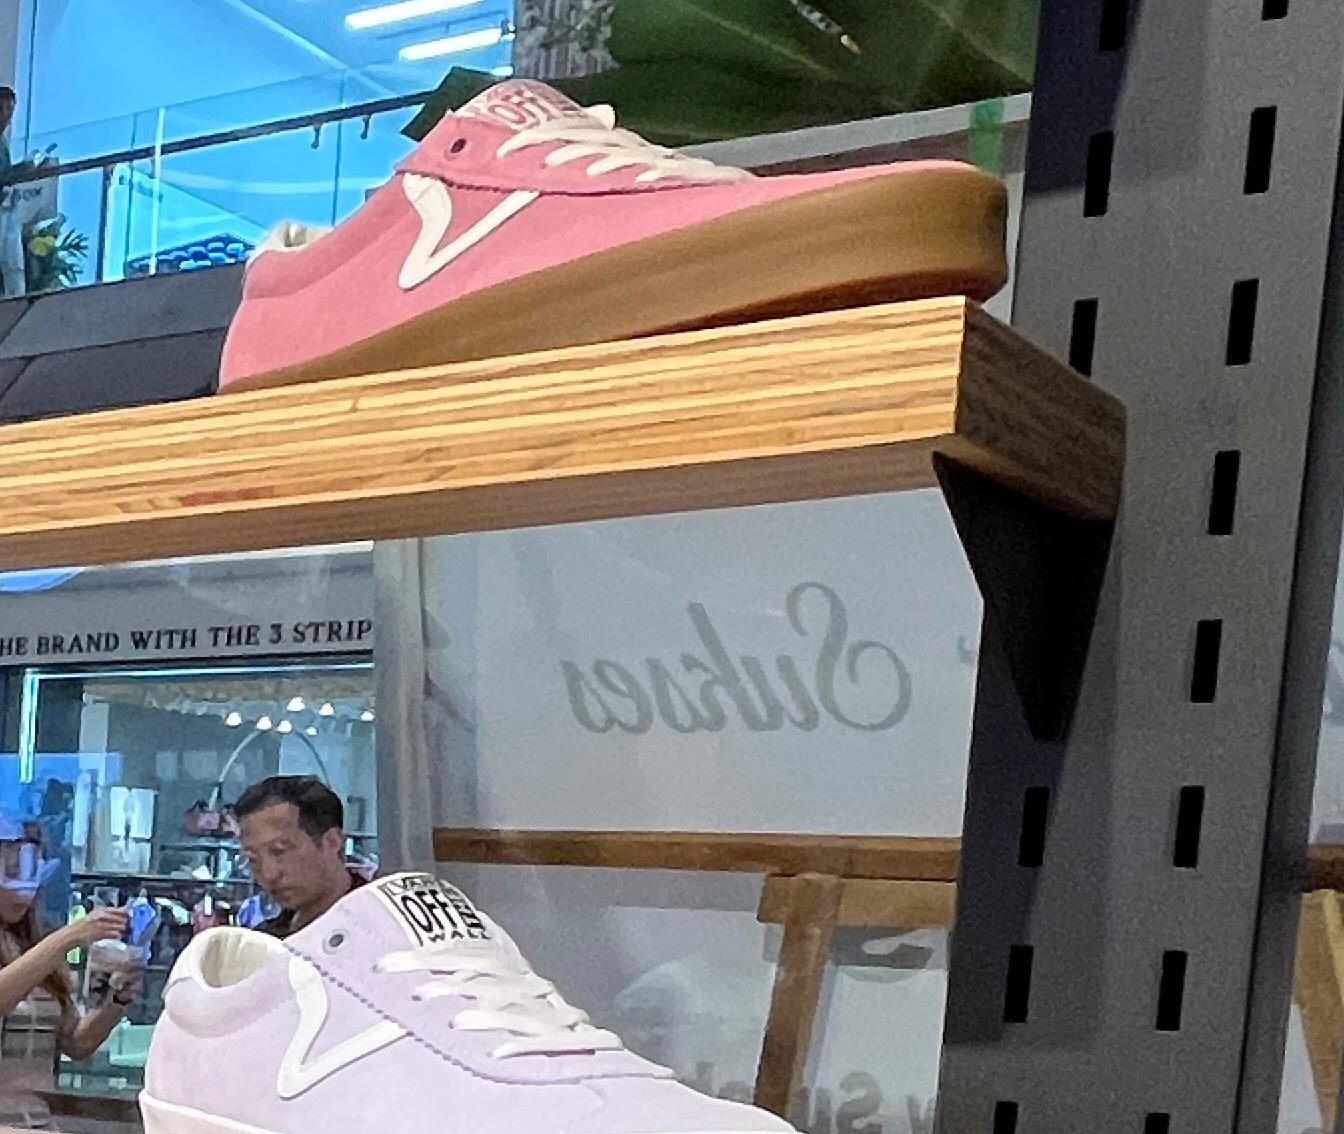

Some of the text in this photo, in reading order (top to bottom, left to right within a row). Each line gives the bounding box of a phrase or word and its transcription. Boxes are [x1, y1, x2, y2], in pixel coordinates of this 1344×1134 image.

[36, 632, 120, 656] BRAND
[130, 628, 197, 651] WITH
[209, 625, 261, 648] THE
[268, 624, 283, 645] 3
[292, 619, 373, 644] STRIP
[401, 889, 457, 933] OFF
